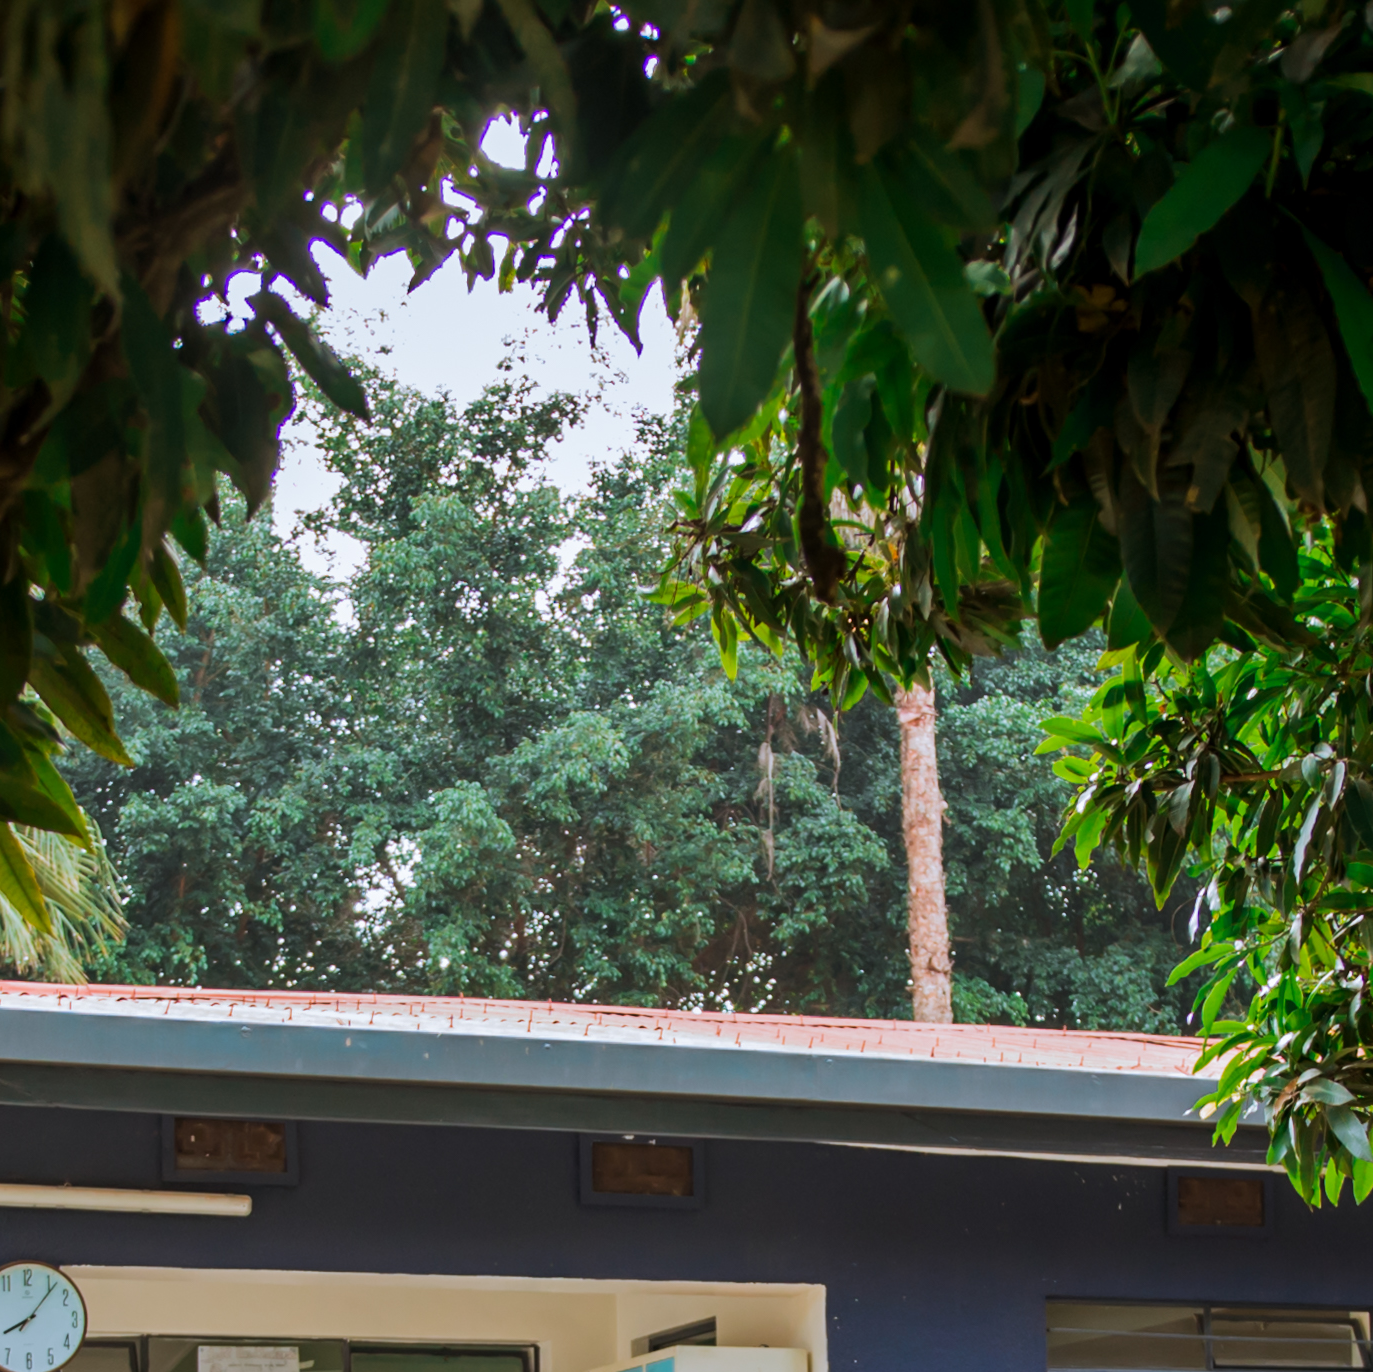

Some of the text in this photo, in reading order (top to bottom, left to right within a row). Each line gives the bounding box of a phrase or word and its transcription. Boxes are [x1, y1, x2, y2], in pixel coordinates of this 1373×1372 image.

[2, 1274, 11, 1292] 11
[22, 1268, 33, 1287] 12
[62, 1288, 70, 1307] 2
[71, 1310, 79, 1329] 3
[63, 1332, 70, 1350] 4
[4, 1347, 12, 1365] 7
[25, 1352, 33, 1370] 6
[47, 1347, 55, 1365] 5
